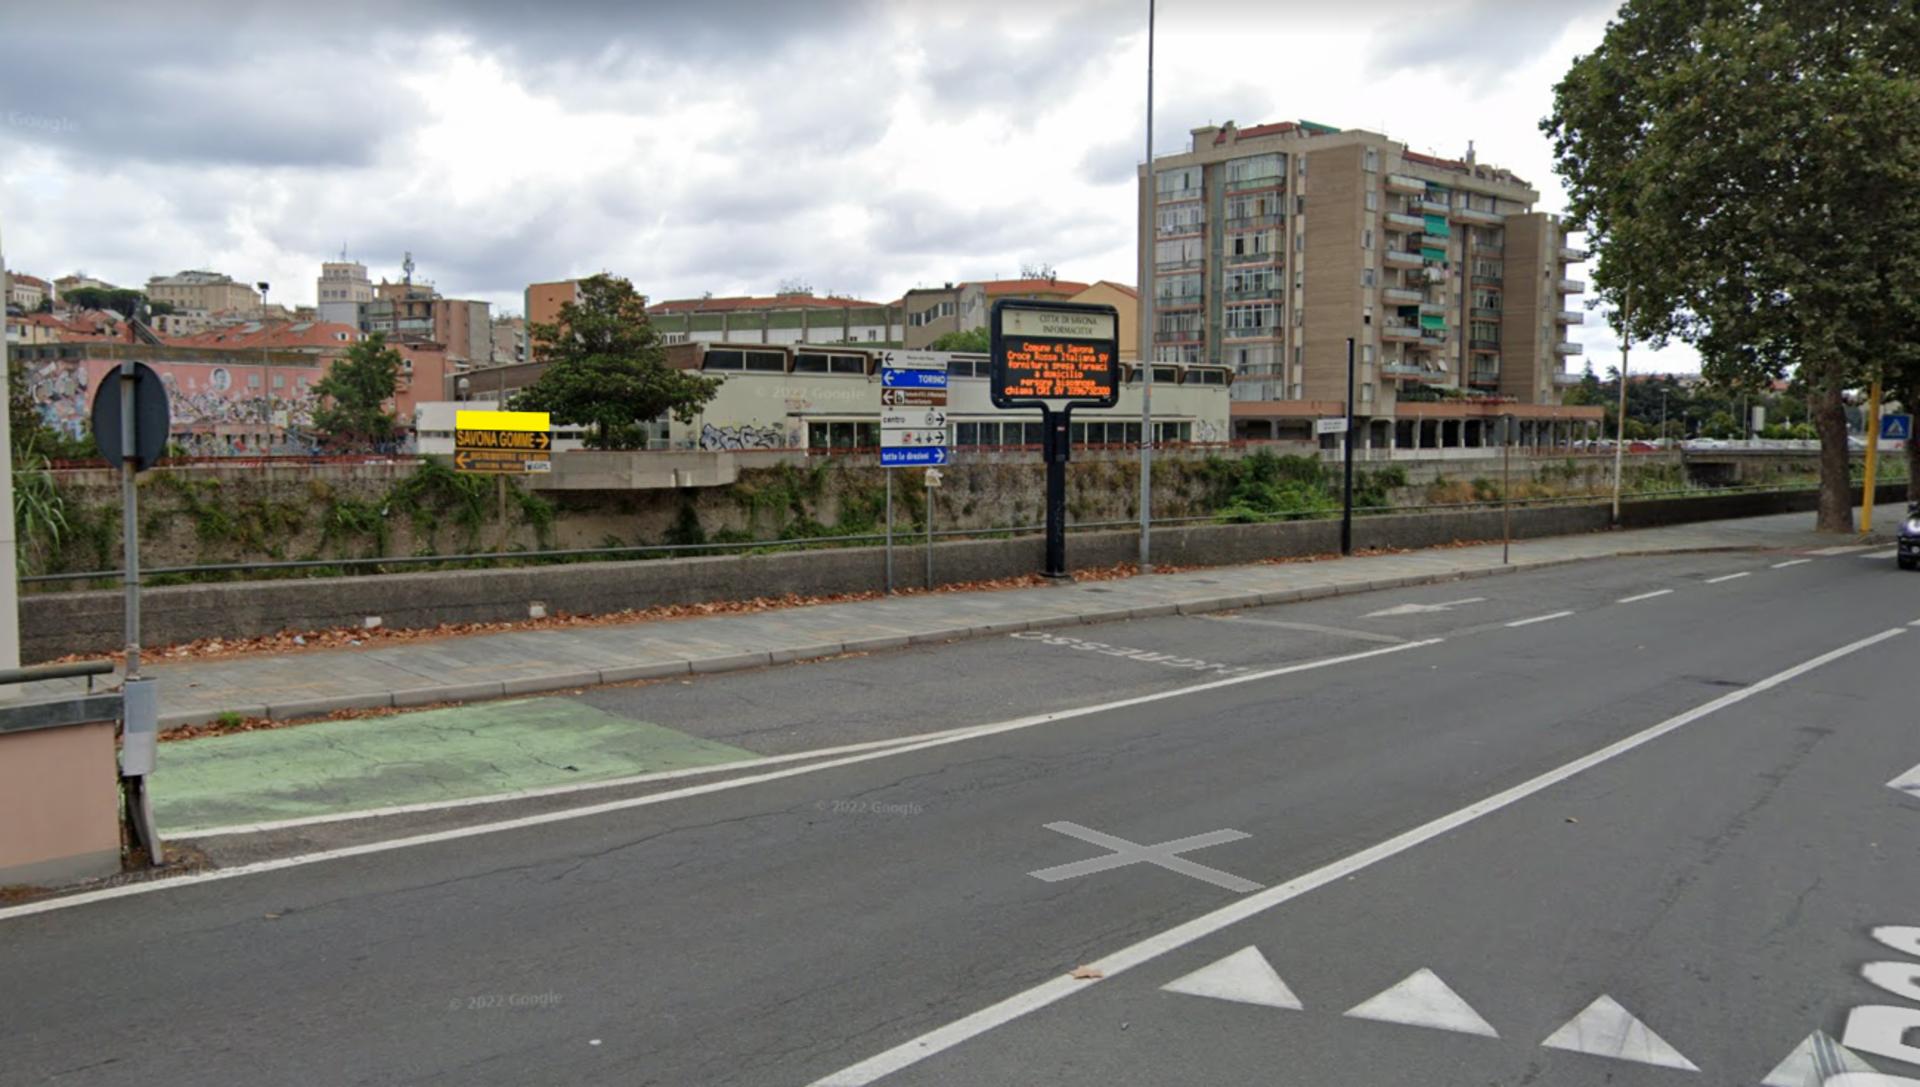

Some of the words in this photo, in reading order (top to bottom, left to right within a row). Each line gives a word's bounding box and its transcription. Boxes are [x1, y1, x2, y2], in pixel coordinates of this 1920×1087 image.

[1023, 343, 1051, 352] Comune
[1055, 344, 1063, 352] di
[1068, 344, 1094, 353] Savona
[1007, 351, 1030, 359] Croce
[1034, 352, 1057, 361] Rossa
[1062, 353, 1096, 362] Italiana
[918, 374, 946, 384] TORINO
[882, 416, 906, 424] centro
[457, 430, 498, 447] SAVONA
[499, 432, 535, 448] GOMME
[882, 452, 898, 461] tutte
